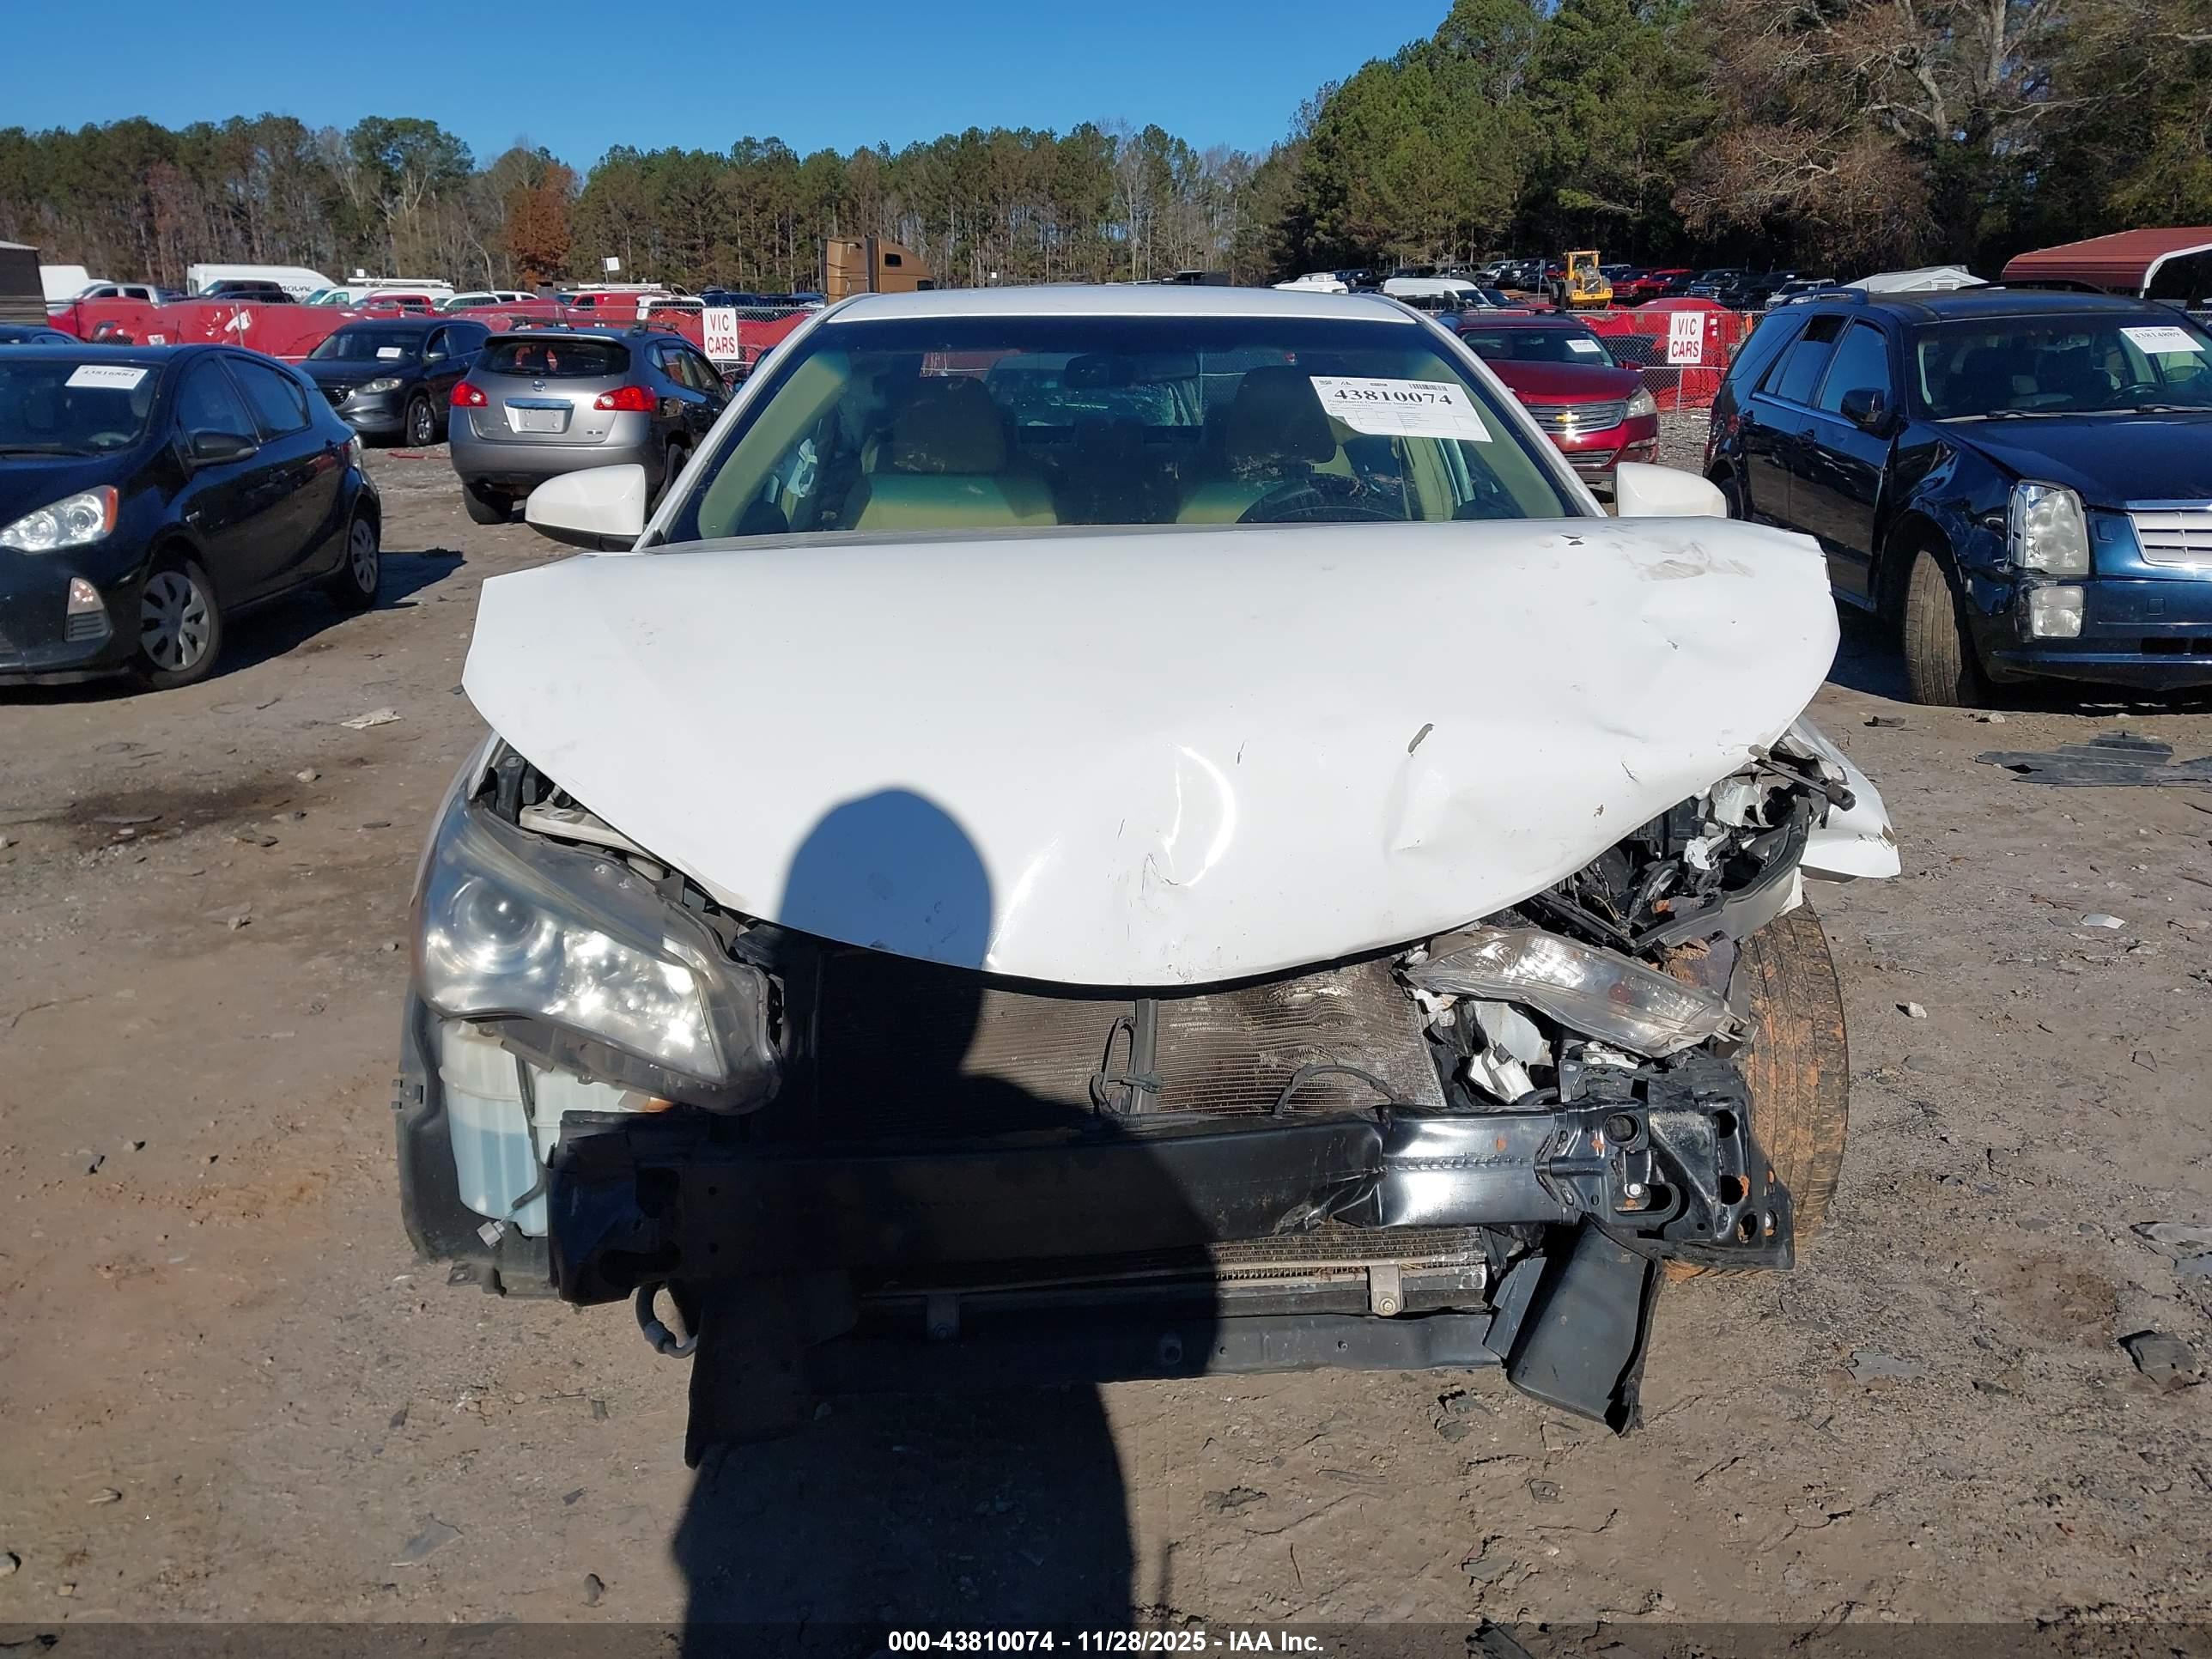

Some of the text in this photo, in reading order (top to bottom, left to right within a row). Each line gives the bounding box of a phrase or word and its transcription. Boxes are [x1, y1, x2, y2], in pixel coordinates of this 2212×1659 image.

[710, 314, 729, 331] VIC
[1678, 318, 1697, 335] VIC
[708, 337, 736, 354] CARS
[1671, 340, 1699, 357] CARS
[1334, 389, 1453, 405] 43810074
